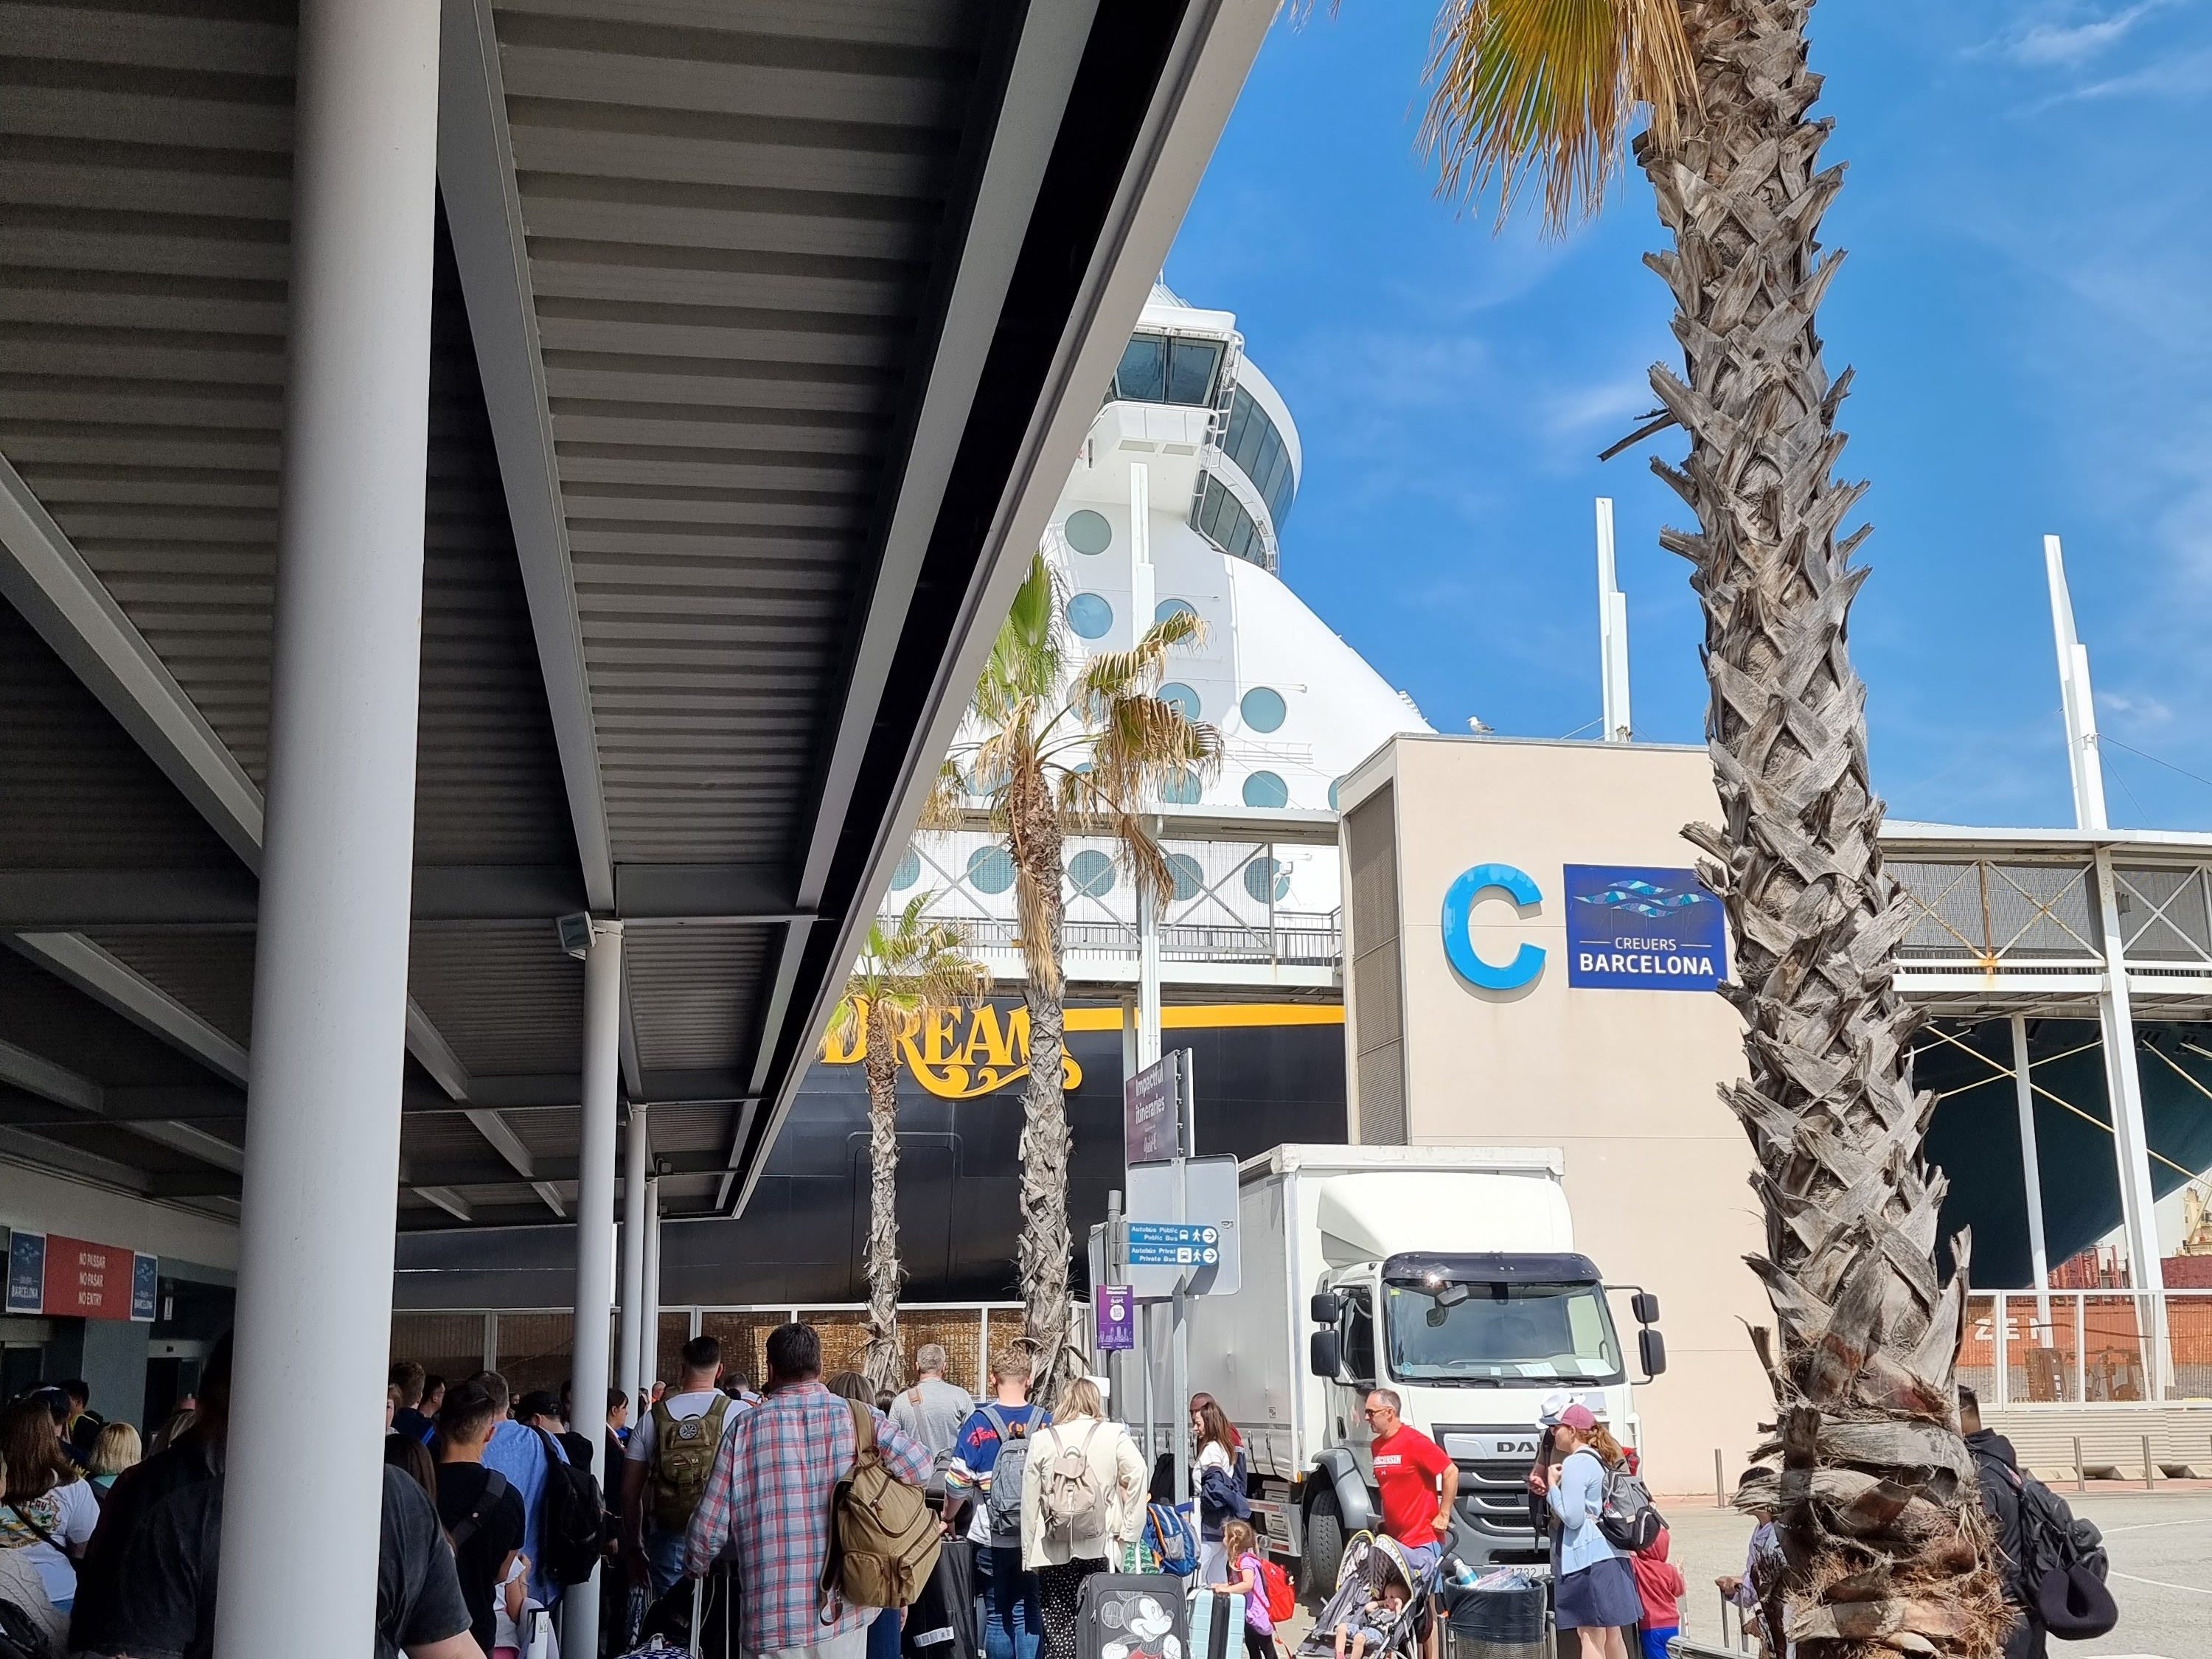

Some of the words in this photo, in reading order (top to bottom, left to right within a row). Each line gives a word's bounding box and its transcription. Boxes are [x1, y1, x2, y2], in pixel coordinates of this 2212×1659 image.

[1441, 863, 1547, 989] C
[1615, 937, 1677, 951] CREUERS
[1579, 953, 1714, 975] BARCELONA
[1135, 1062, 1164, 1097] Impactful
[79, 1252, 87, 1265] NO
[87, 1253, 106, 1269] PASSAR
[80, 1272, 88, 1285] NO
[88, 1273, 104, 1287] PASAR
[78, 1292, 86, 1305] NO
[87, 1292, 102, 1307] ENTRY
[1497, 1441, 1540, 1453] DA
